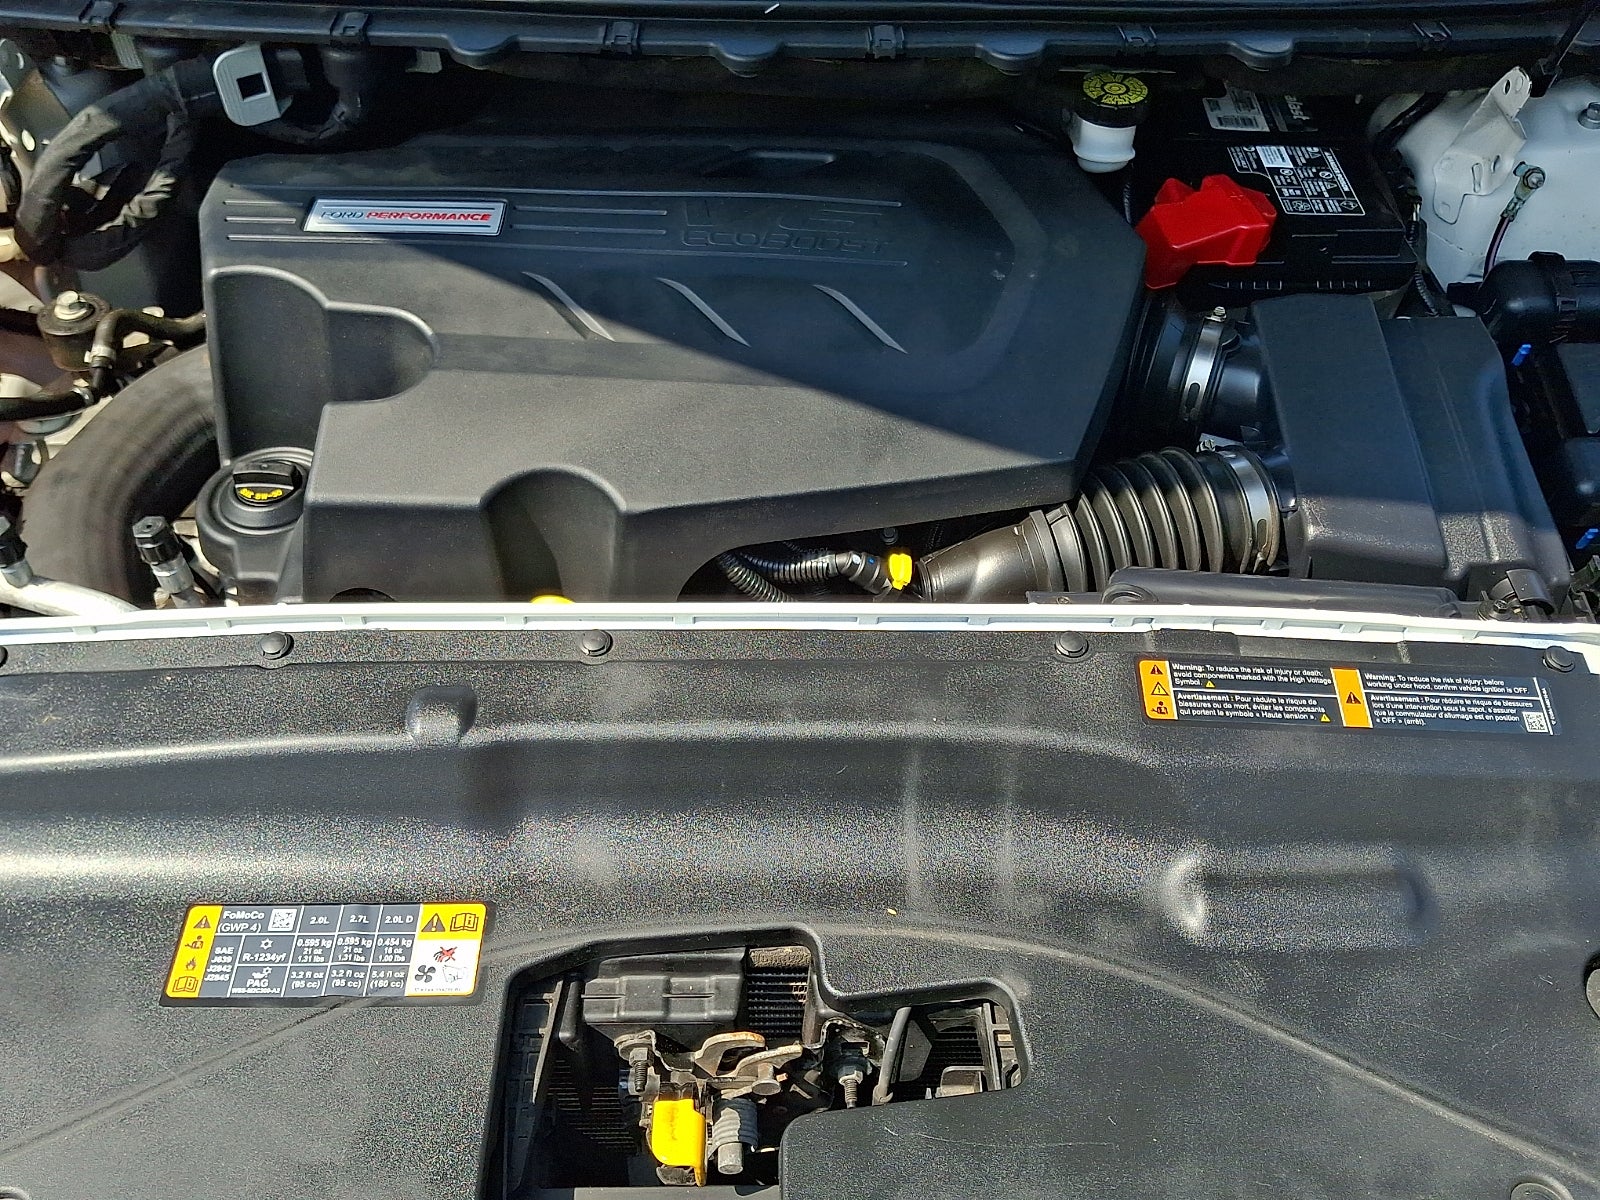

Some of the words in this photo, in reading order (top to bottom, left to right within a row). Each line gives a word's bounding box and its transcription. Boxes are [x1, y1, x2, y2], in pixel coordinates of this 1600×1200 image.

[321, 211, 365, 219] FORD
[366, 211, 491, 222] PERFORMANCE
[1172, 663, 1205, 672] Warning:
[1206, 664, 1215, 672] To
[1274, 668, 1292, 677] injury
[1193, 672, 1235, 680] components
[1290, 676, 1306, 684] High
[1307, 677, 1332, 686] Voltage
[1364, 673, 1397, 682] Warning:
[1397, 674, 1406, 682] To
[1407, 675, 1429, 683] reduce
[1366, 681, 1393, 689] working
[1433, 683, 1458, 691] confirm
[1482, 686, 1506, 694] ignition
[1177, 693, 1230, 702] Avertissement
[1235, 695, 1252, 703] Pour
[1253, 695, 1277, 703] réduire
[1286, 697, 1307, 706] risque
[1370, 694, 1420, 703] Avertissement
[1441, 697, 1464, 705] réduire
[1472, 699, 1492, 708] risque
[1503, 700, 1533, 708] blessures
[1178, 700, 1212, 708] blessures
[1252, 703, 1272, 711] éviter
[1273, 704, 1283, 712] les
[1284, 705, 1326, 713] composants
[1404, 703, 1442, 711] intervention
[1192, 709, 1216, 717] portent
[1225, 709, 1254, 718] symbole
[1261, 711, 1282, 719] Haute
[1283, 712, 1309, 720] tension
[1395, 711, 1437, 719] commutateur
[1494, 714, 1520, 722] position
[222, 910, 265, 920] FoMoCo
[309, 916, 330, 925] 2.0L
[349, 914, 370, 924] 2.7L
[384, 915, 404, 924] 2.0L
[405, 915, 414, 924] D
[217, 922, 249, 933] (GWP
[250, 922, 262, 933] 4)
[321, 938, 333, 949] kg
[361, 937, 373, 948] kg
[401, 938, 413, 948] kg
[214, 946, 235, 955] SAE
[242, 952, 287, 963] R-1234yf
[313, 971, 325, 979] oz
[354, 971, 366, 979] oz
[246, 979, 270, 988] PAG
